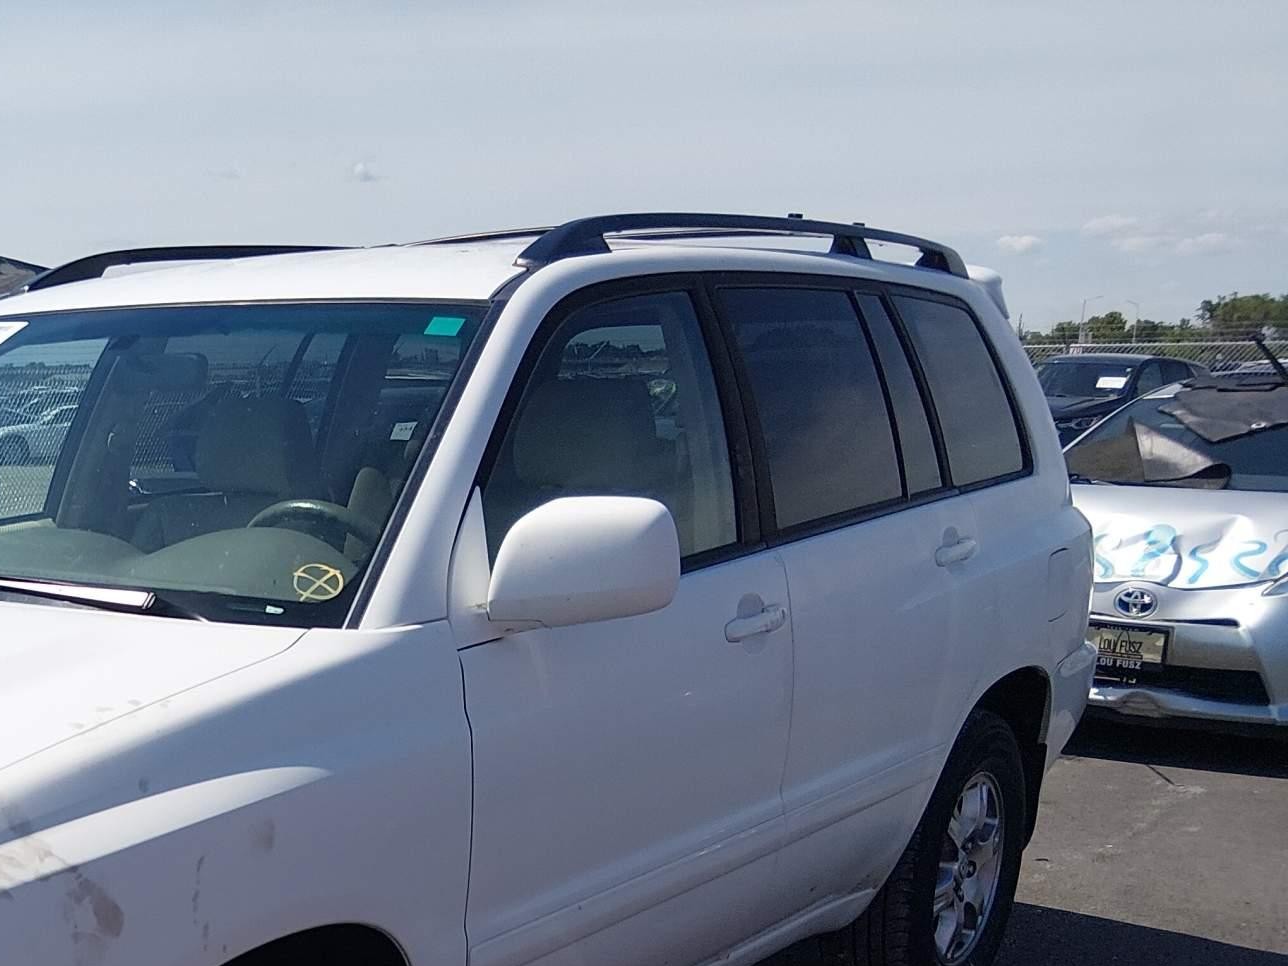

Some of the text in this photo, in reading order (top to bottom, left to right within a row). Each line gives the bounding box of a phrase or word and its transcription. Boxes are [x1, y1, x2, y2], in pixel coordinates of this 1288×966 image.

[1099, 634, 1143, 653] LOU FUSZ
[1116, 659, 1142, 670] FUSZ
